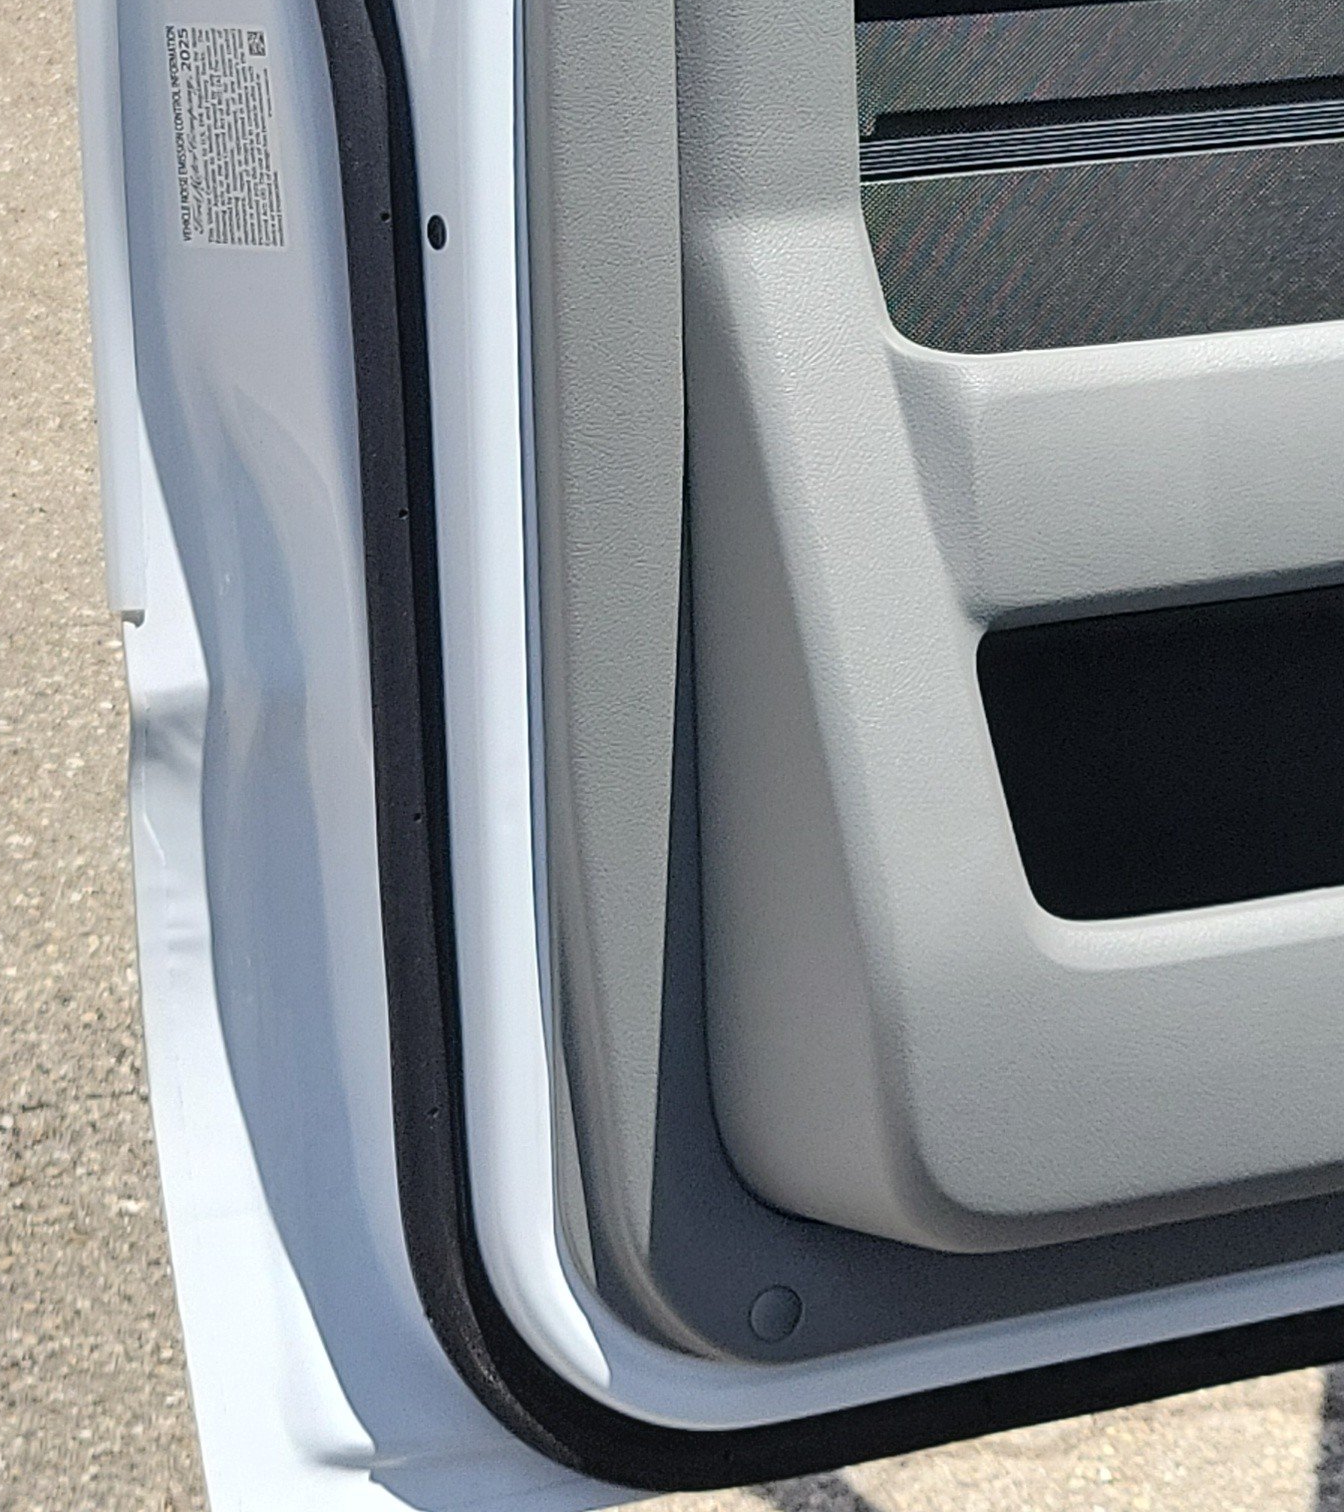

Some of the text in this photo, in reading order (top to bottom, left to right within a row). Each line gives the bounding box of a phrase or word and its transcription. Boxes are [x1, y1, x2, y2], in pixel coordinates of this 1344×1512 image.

[179, 29, 191, 71] 2025
[166, 26, 191, 241] VEHICLE NOISE EMISSION CONTROL INFORMATION
